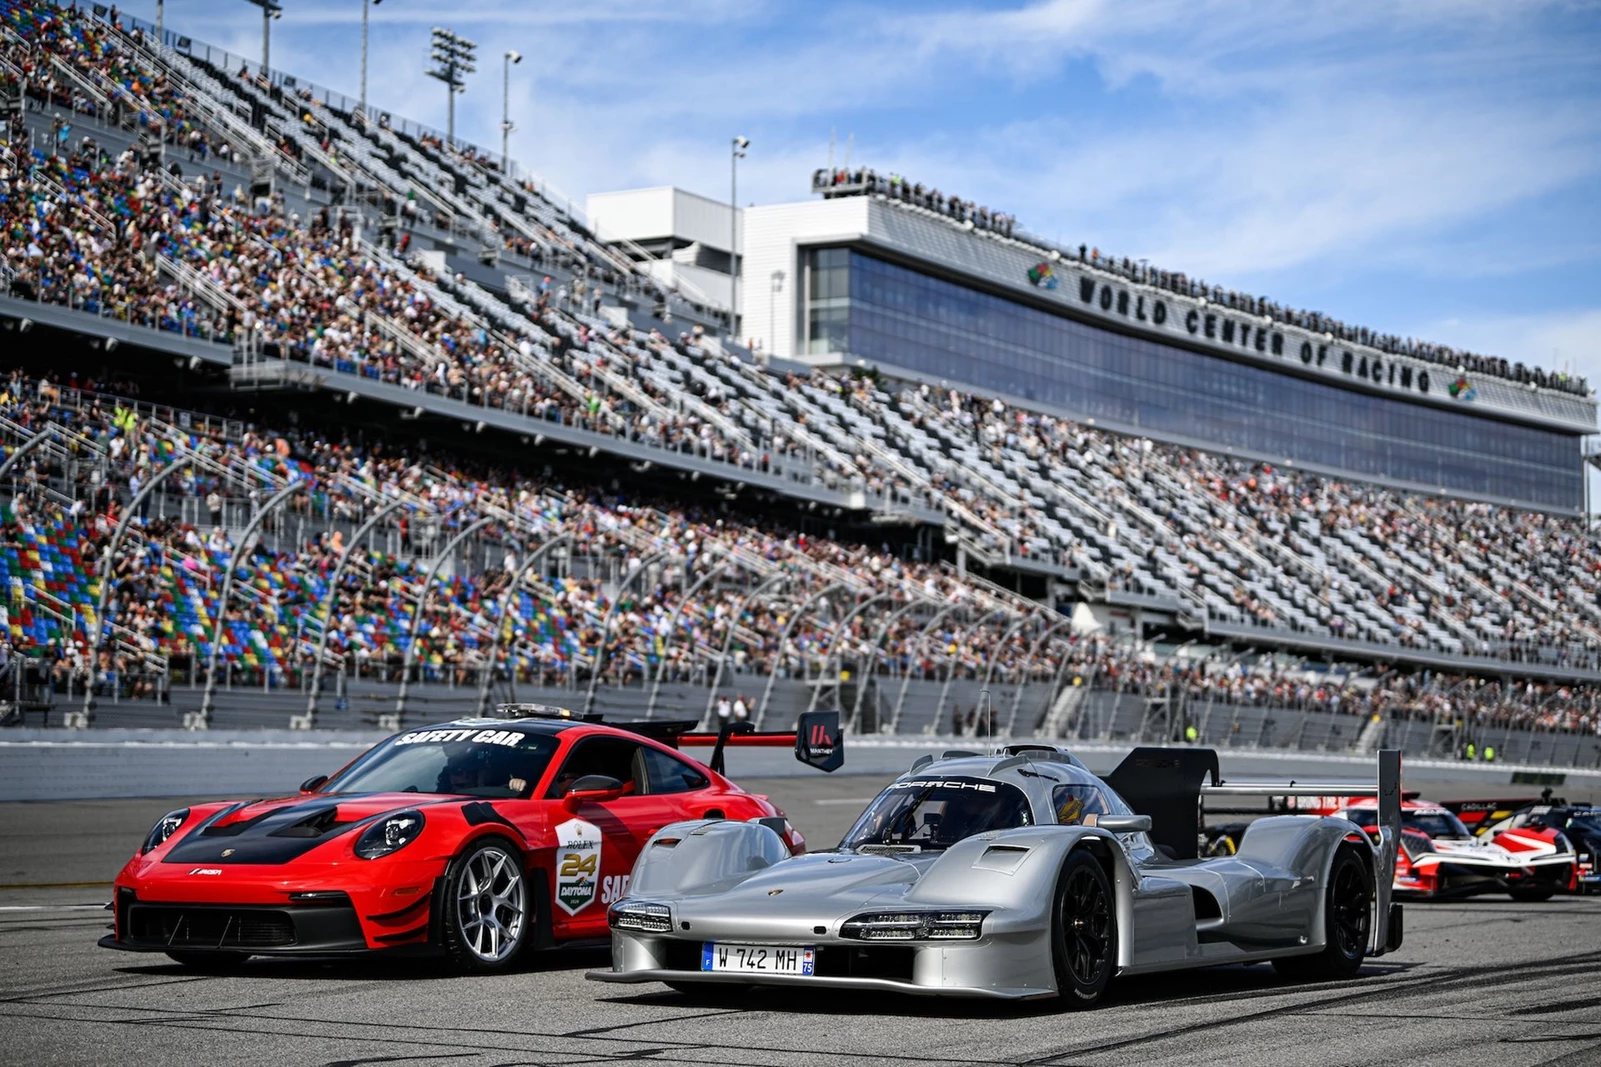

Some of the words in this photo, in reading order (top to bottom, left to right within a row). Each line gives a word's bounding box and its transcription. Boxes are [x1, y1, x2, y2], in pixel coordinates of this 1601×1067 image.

[1080, 276, 1167, 325] WORLD
[1186, 309, 1284, 355] CENTER
[1301, 341, 1327, 367] OF
[1342, 351, 1429, 393] RACING
[395, 730, 478, 746] SAFETY
[472, 729, 525, 746] CAR
[889, 781, 996, 793] PORSCHE
[567, 840, 594, 850] ROLEX
[560, 853, 598, 877] 24
[561, 886, 592, 897] DAYTONA
[719, 947, 729, 968] W
[736, 948, 768, 969] 742
[775, 950, 797, 971] MH
[803, 963, 813, 973] 75
